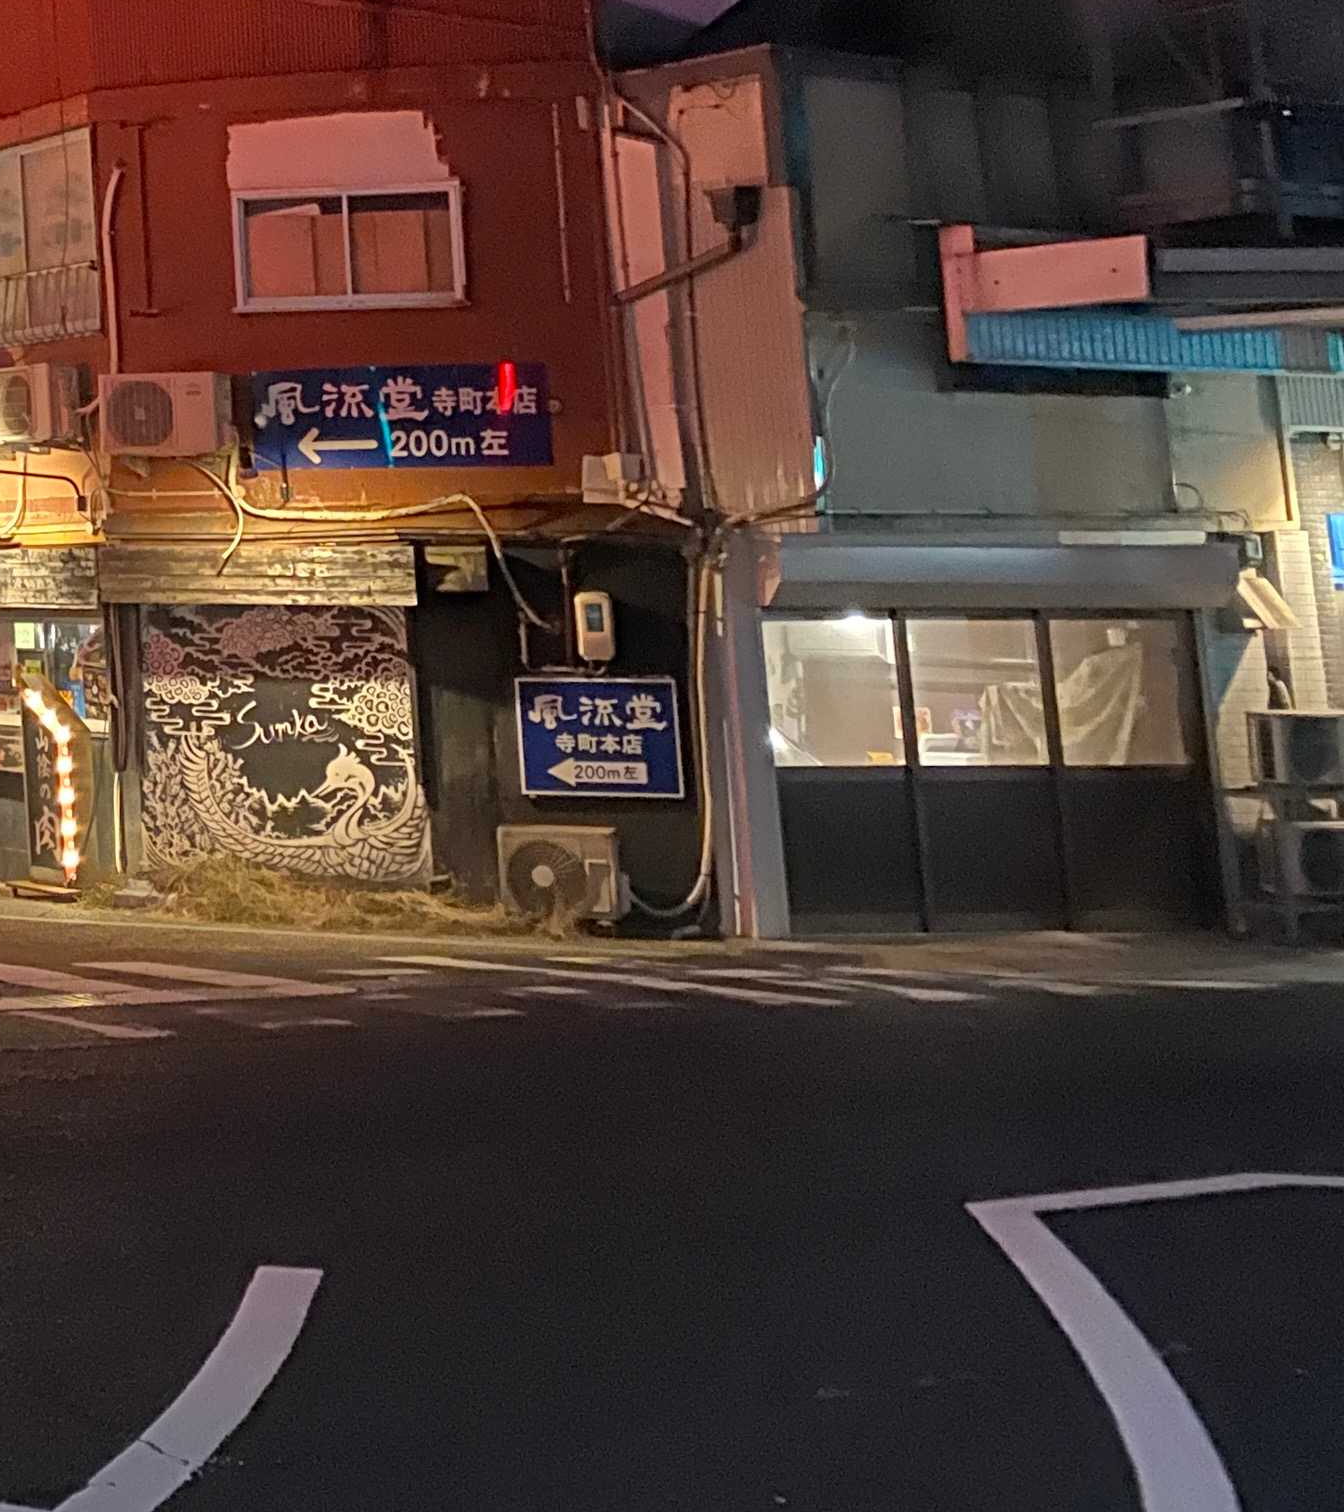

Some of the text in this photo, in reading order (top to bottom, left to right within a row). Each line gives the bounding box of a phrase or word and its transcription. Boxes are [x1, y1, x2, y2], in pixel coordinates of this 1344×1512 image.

[262, 375, 429, 425] 風流堂
[527, 692, 669, 731] 風流堂
[554, 732, 644, 755] 寺町本店
